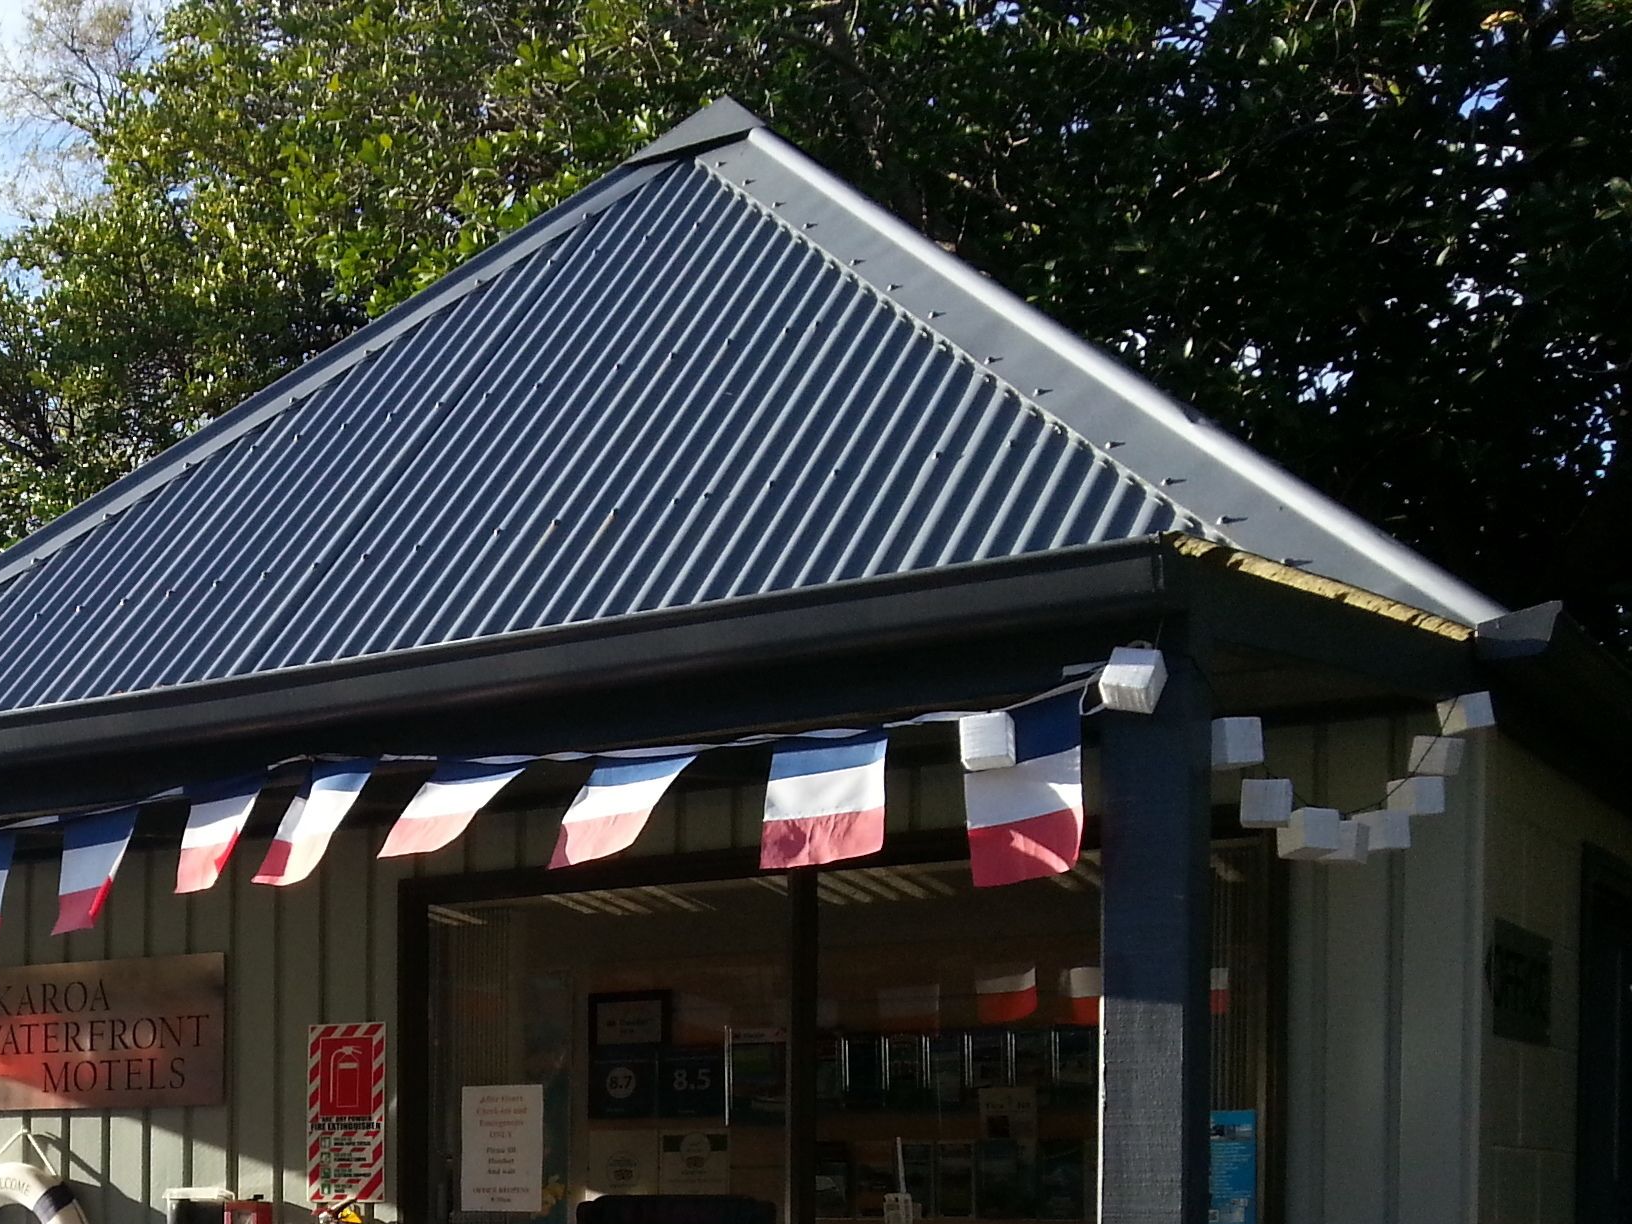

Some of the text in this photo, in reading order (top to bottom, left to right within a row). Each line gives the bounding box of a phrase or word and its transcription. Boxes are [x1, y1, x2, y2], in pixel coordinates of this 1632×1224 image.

[42, 1057, 185, 1093] MOTELS
[672, 1068, 712, 1091] 8.5
[311, 1121, 381, 1131] FIRE EXTINGUISHER
